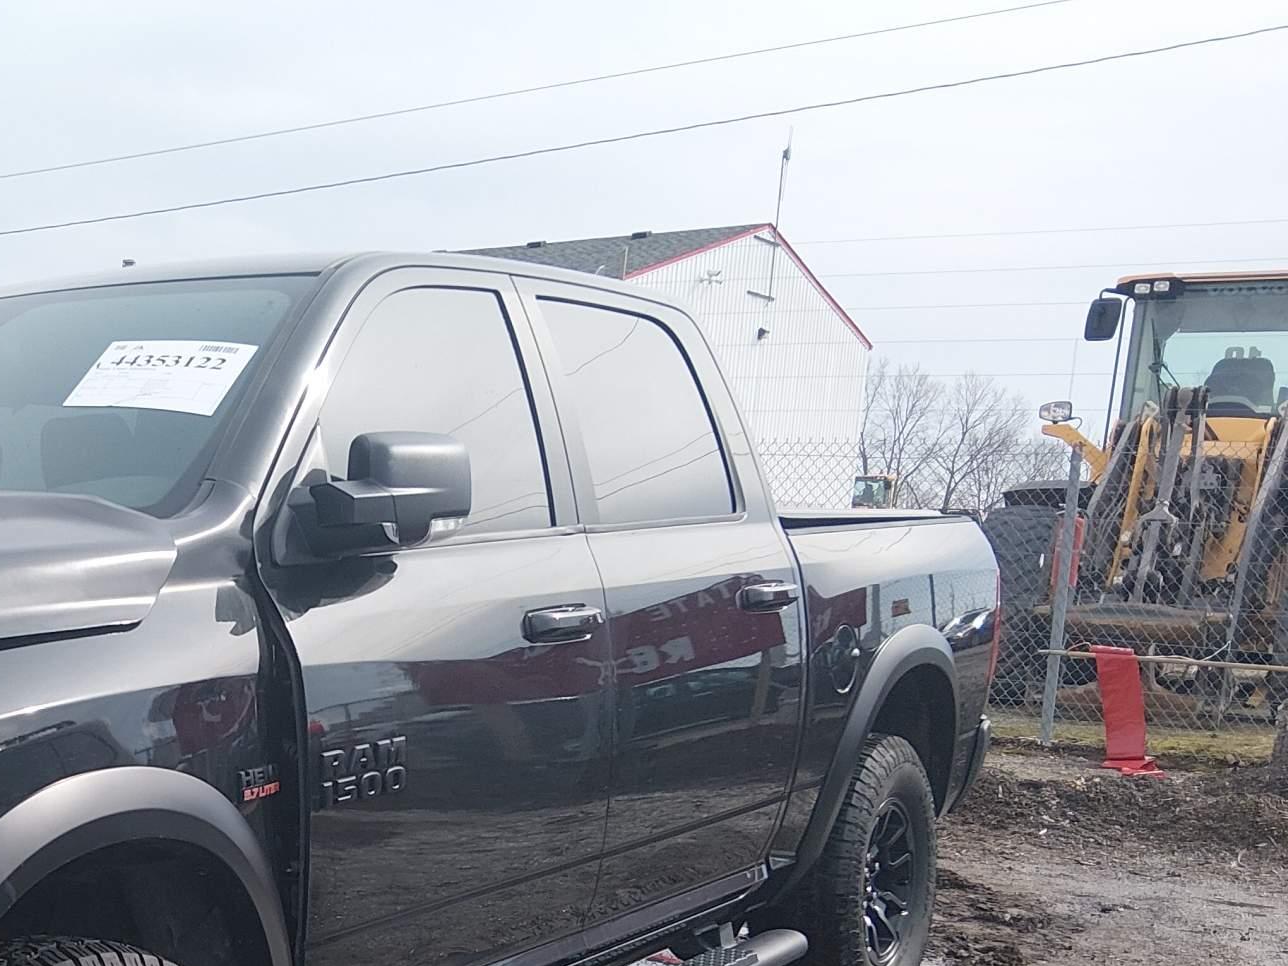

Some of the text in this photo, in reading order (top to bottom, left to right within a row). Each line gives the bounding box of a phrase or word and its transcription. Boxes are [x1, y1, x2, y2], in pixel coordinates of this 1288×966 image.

[110, 354, 228, 371] 44353122
[321, 736, 407, 777] RAM
[322, 765, 407, 806] 1500
